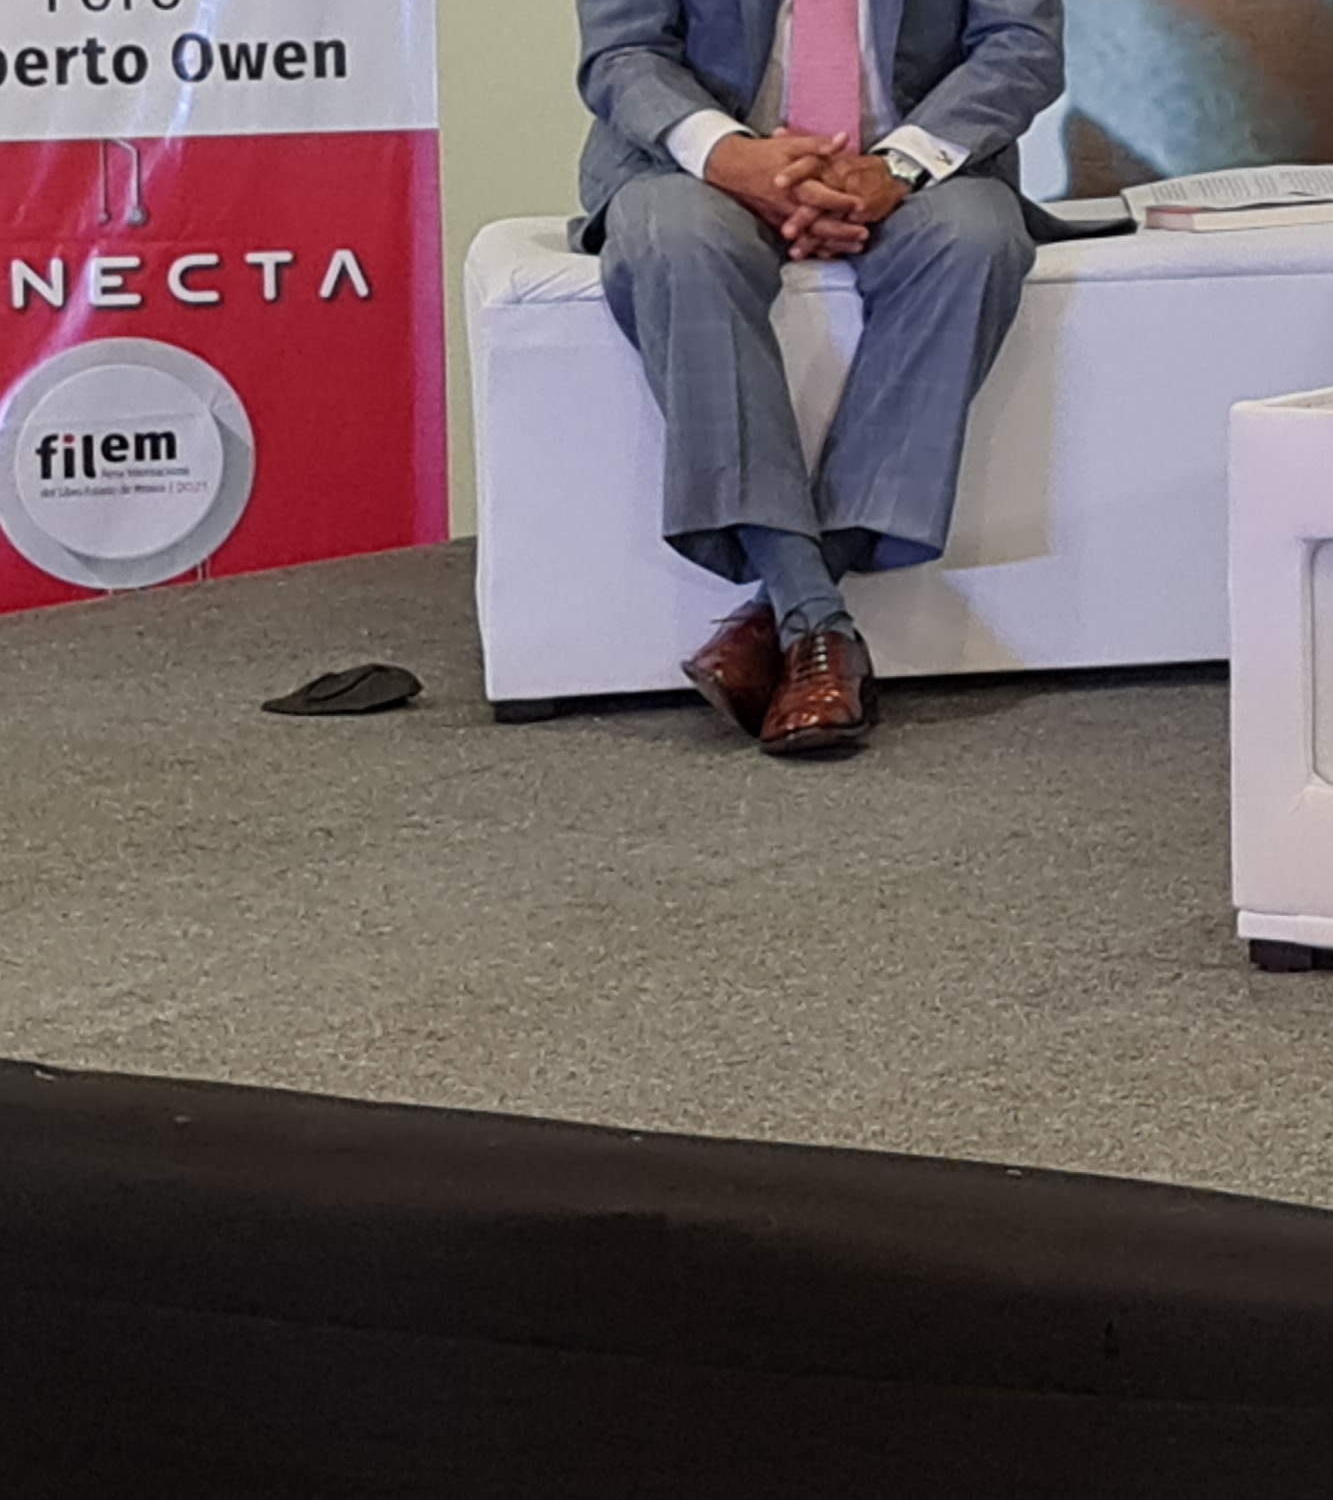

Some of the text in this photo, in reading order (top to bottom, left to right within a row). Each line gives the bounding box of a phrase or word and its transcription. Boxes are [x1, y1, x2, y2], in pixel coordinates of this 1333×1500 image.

[0, 32, 347, 88] erto Owen
[36, 431, 177, 480] filem
